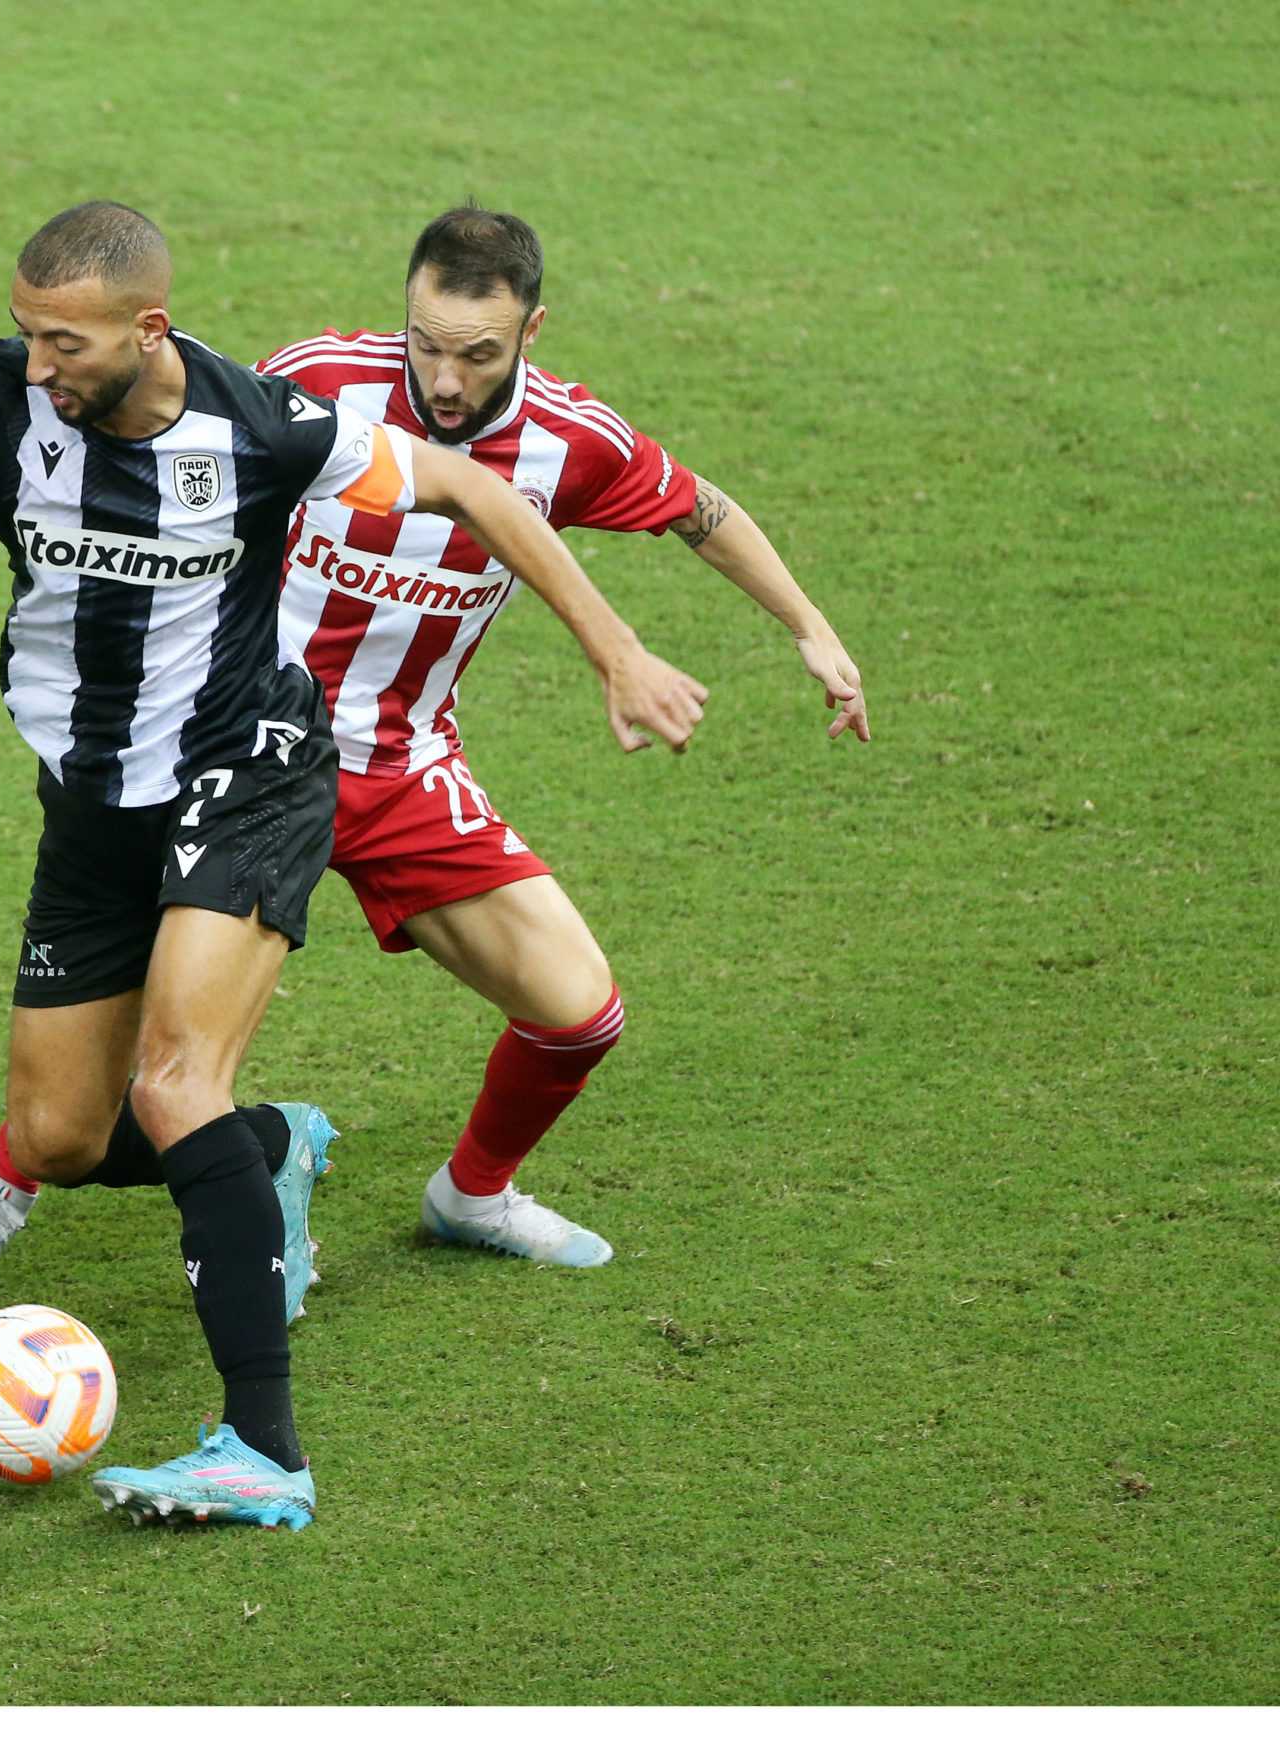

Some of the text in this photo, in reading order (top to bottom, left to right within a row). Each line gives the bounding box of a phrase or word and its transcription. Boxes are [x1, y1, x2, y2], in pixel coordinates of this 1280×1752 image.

[179, 461, 212, 471] ΠΑΟΚ
[296, 534, 503, 611] Stoiximan
[180, 768, 234, 827] 7
